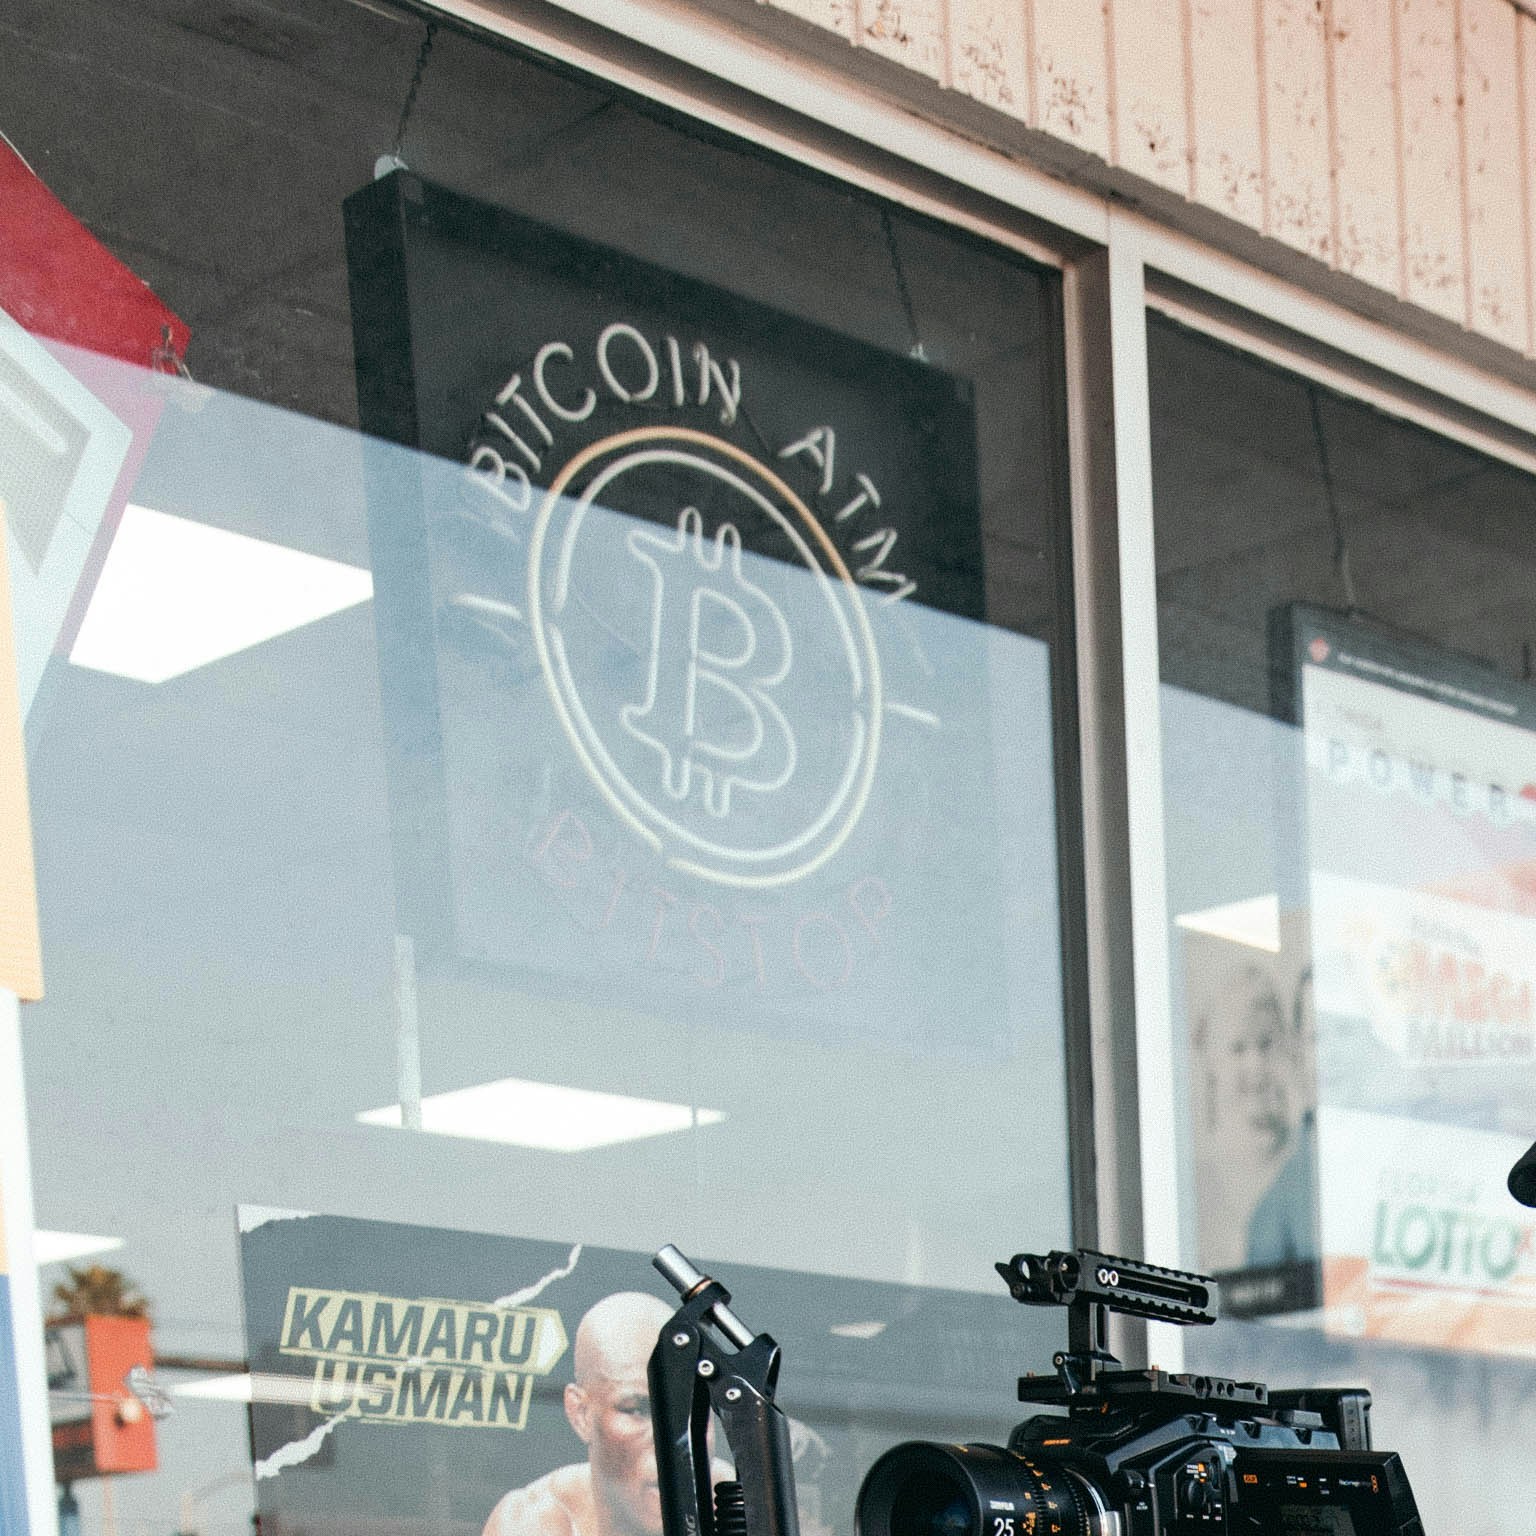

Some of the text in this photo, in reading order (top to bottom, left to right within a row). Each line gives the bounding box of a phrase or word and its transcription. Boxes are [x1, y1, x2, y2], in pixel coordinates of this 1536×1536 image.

[467, 322, 918, 607] BITCOIN ATM
[1373, 1199, 1521, 1281] LOTTO
[286, 1293, 538, 1366] KAMARU
[314, 1356, 529, 1426] USMAN
